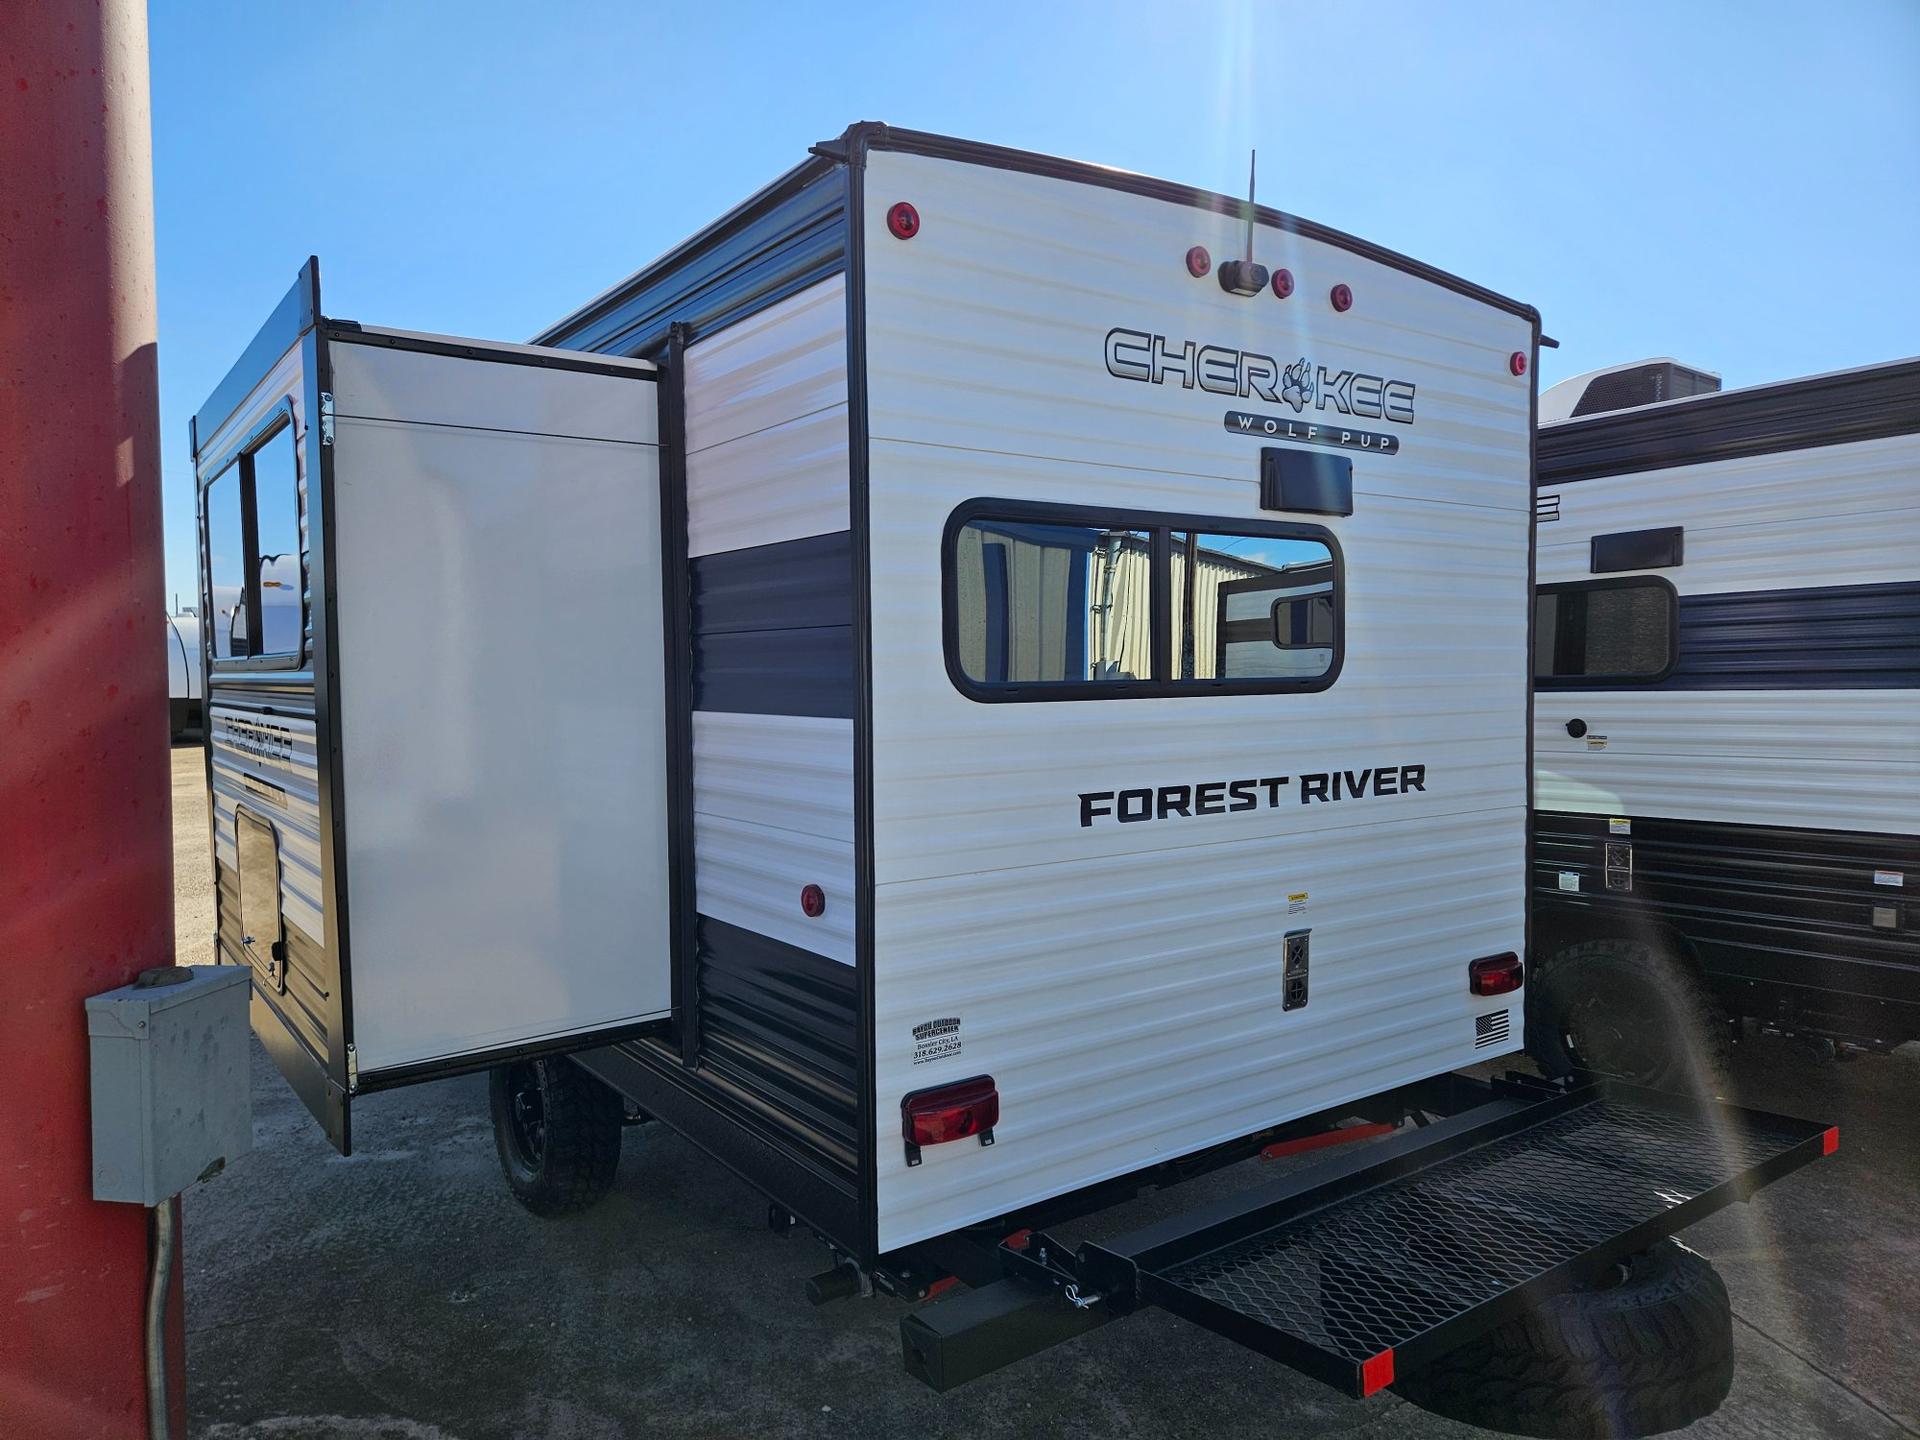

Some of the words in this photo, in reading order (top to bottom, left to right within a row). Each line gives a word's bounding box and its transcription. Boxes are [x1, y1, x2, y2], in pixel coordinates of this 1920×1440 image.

[1104, 327, 1417, 424] CHEROKEE
[1237, 415, 1319, 440] WOLF
[1341, 431, 1390, 450] PUP
[1077, 776, 1290, 828] FOREST
[1299, 764, 1427, 805] RIVER
[913, 1041, 962, 1059] 318.629.2628
[915, 1025, 959, 1041] SUPERCENTER
